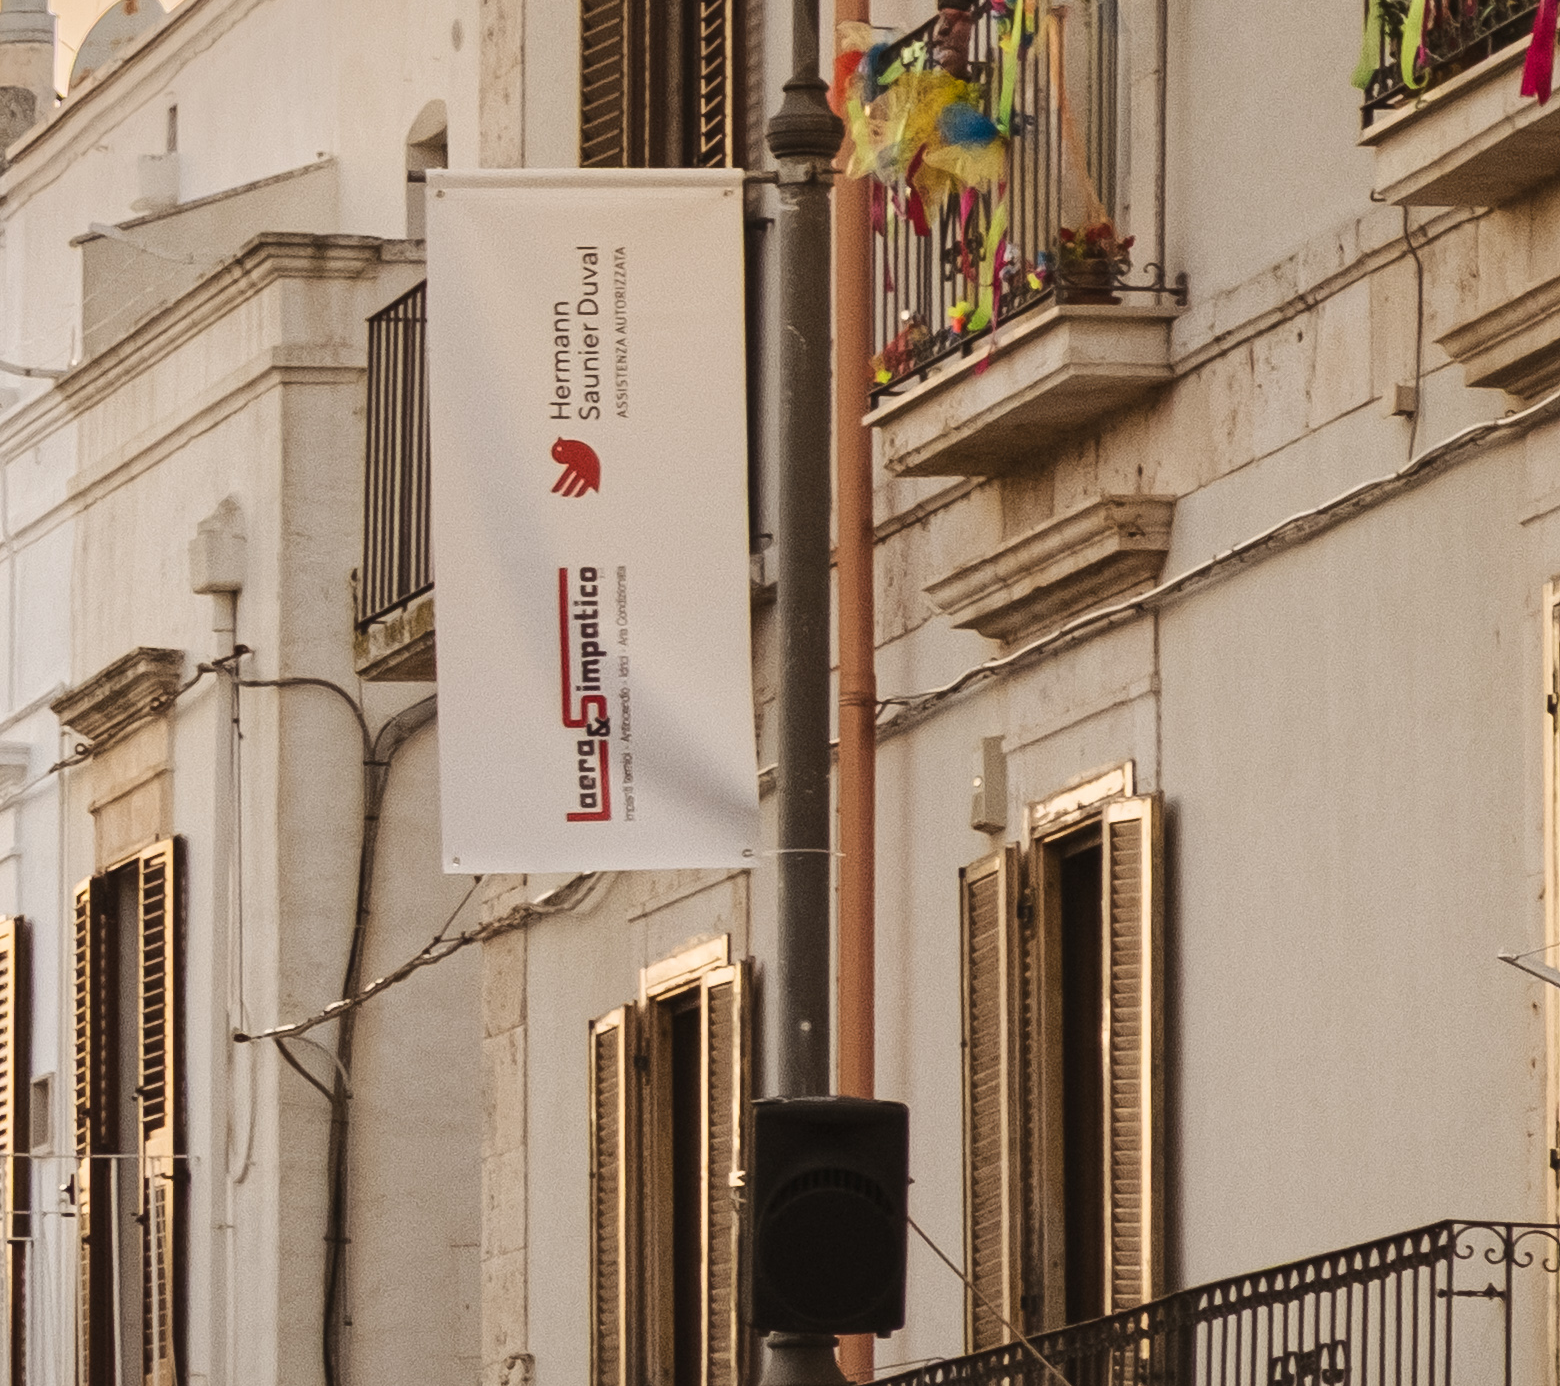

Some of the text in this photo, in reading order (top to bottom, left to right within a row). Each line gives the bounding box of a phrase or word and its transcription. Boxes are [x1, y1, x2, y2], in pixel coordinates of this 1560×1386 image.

[549, 300, 571, 421] Hermann
[577, 245, 601, 421] Saunier Duval
[614, 246, 629, 419] ASSISTENZA AUTORIZZATA
